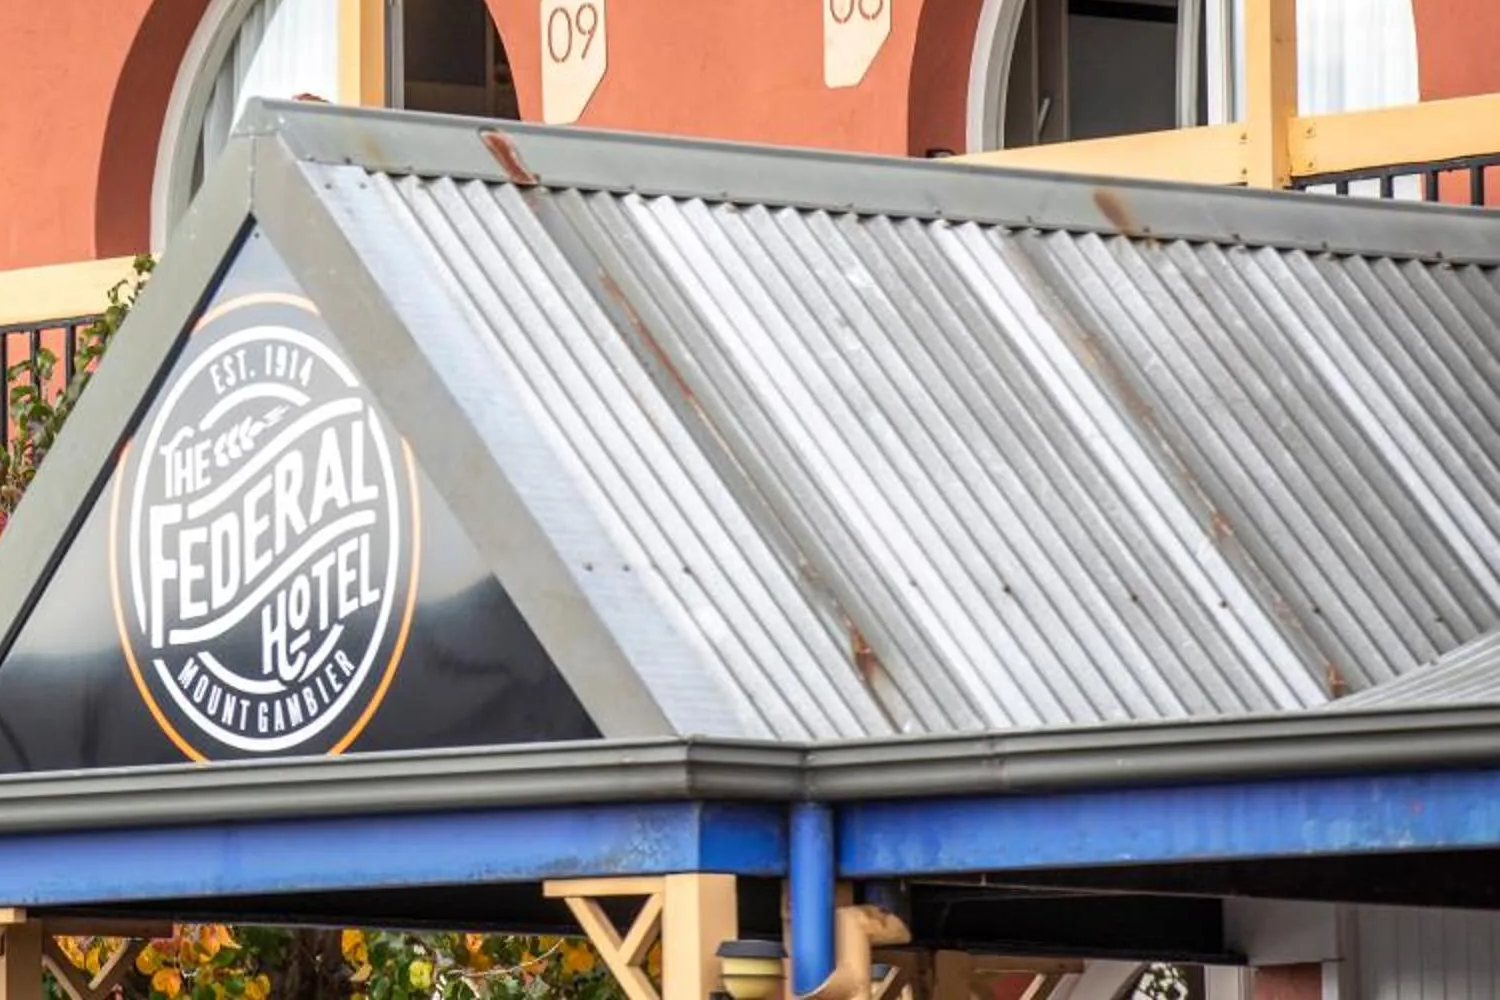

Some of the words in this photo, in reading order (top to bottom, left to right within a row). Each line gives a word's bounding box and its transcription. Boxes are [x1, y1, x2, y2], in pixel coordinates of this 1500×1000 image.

[547, 3, 598, 63] 09
[209, 350, 256, 394] EST.
[264, 345, 314, 387] 1914
[159, 425, 212, 499] THE
[149, 420, 379, 649] FEDERAL
[261, 532, 382, 681] HOTEL
[176, 656, 250, 732] MOUNT
[256, 648, 356, 733] GAMBIER
